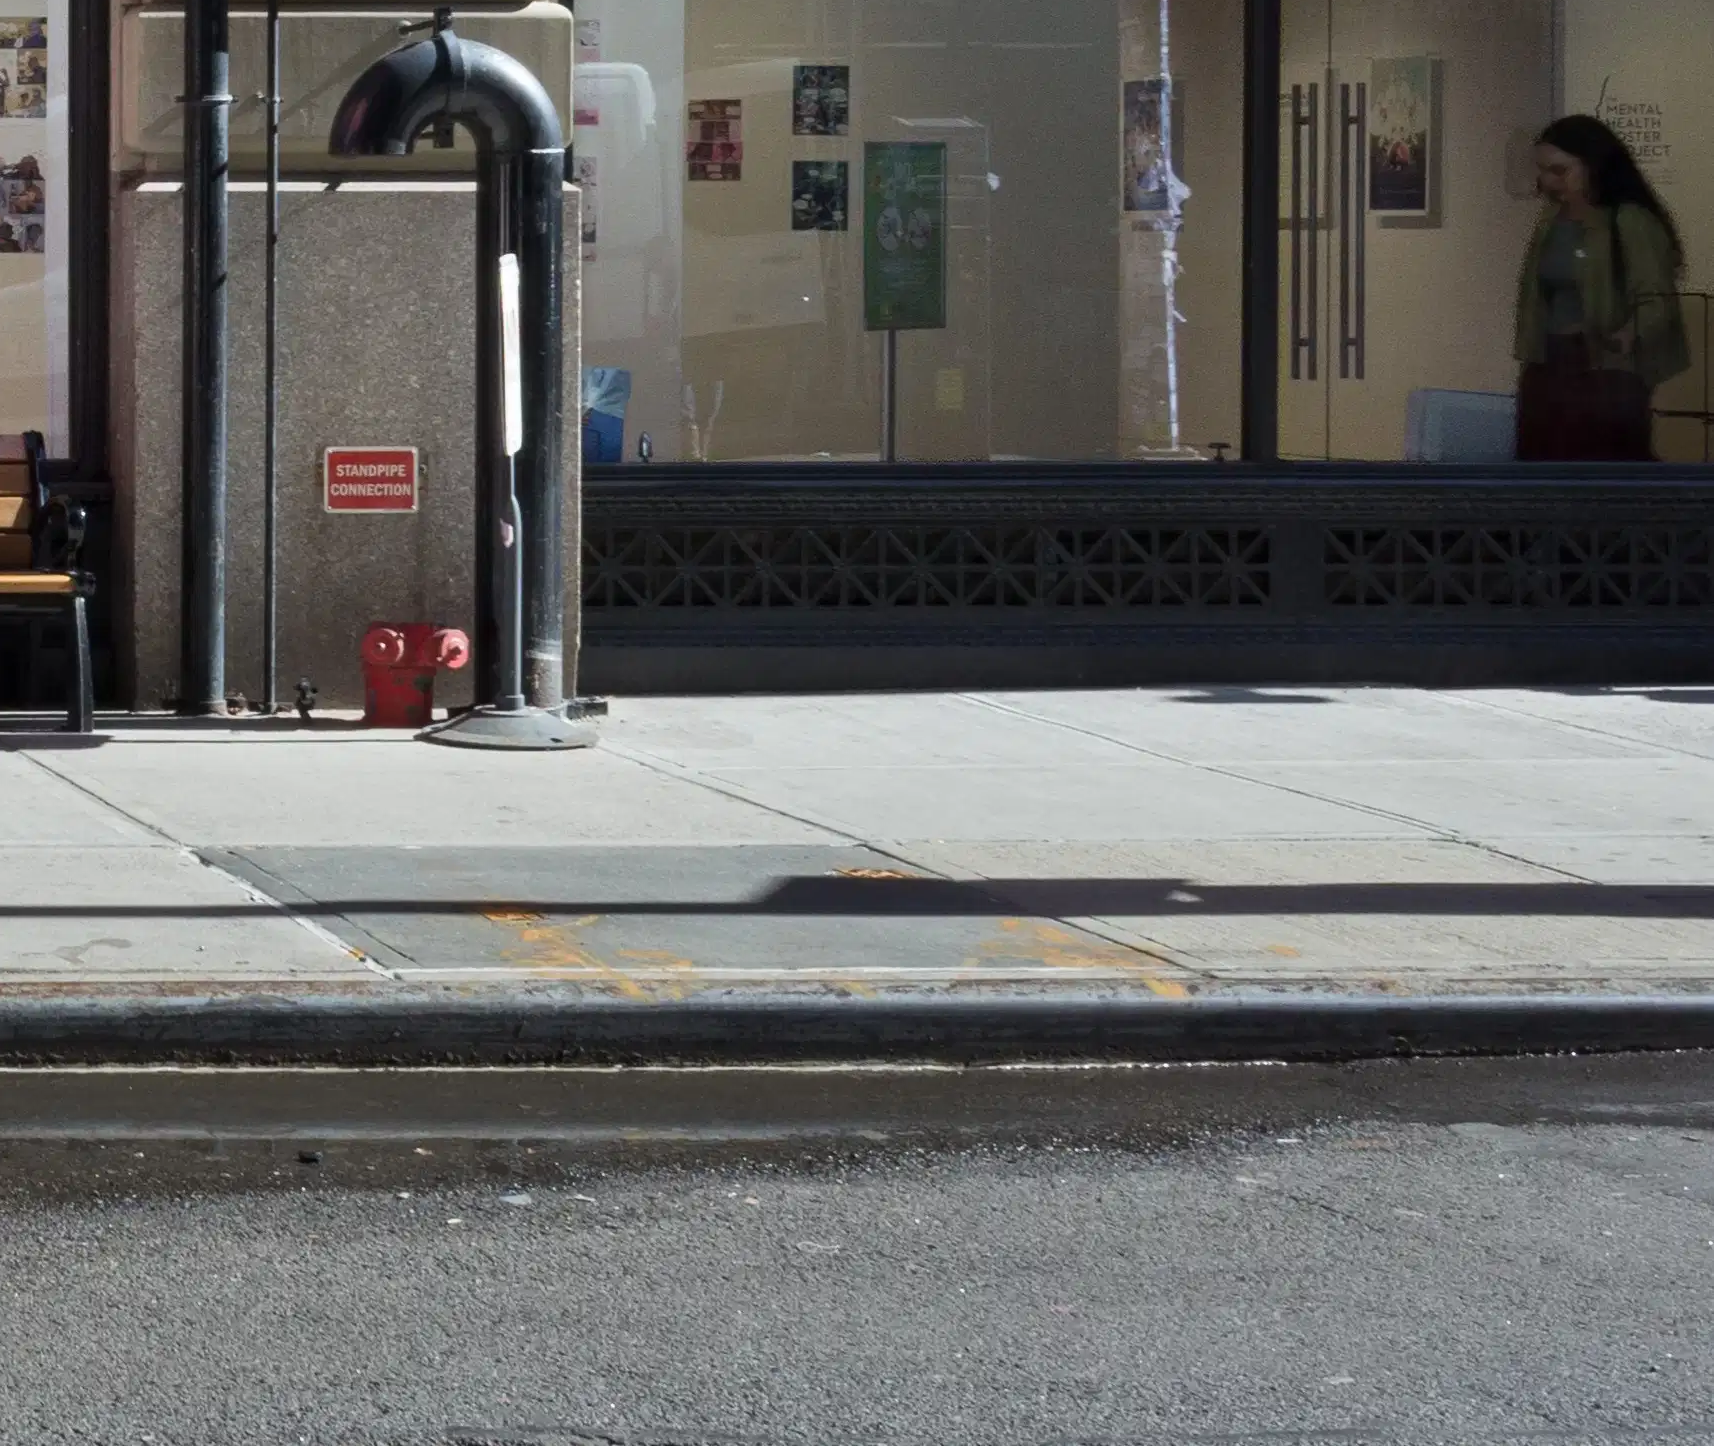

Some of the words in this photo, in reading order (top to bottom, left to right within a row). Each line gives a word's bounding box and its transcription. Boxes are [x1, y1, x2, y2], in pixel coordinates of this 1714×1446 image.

[1606, 103, 1663, 115] MENTAL
[335, 464, 407, 477] STANDPIPE
[330, 483, 412, 496] CONNECTION
